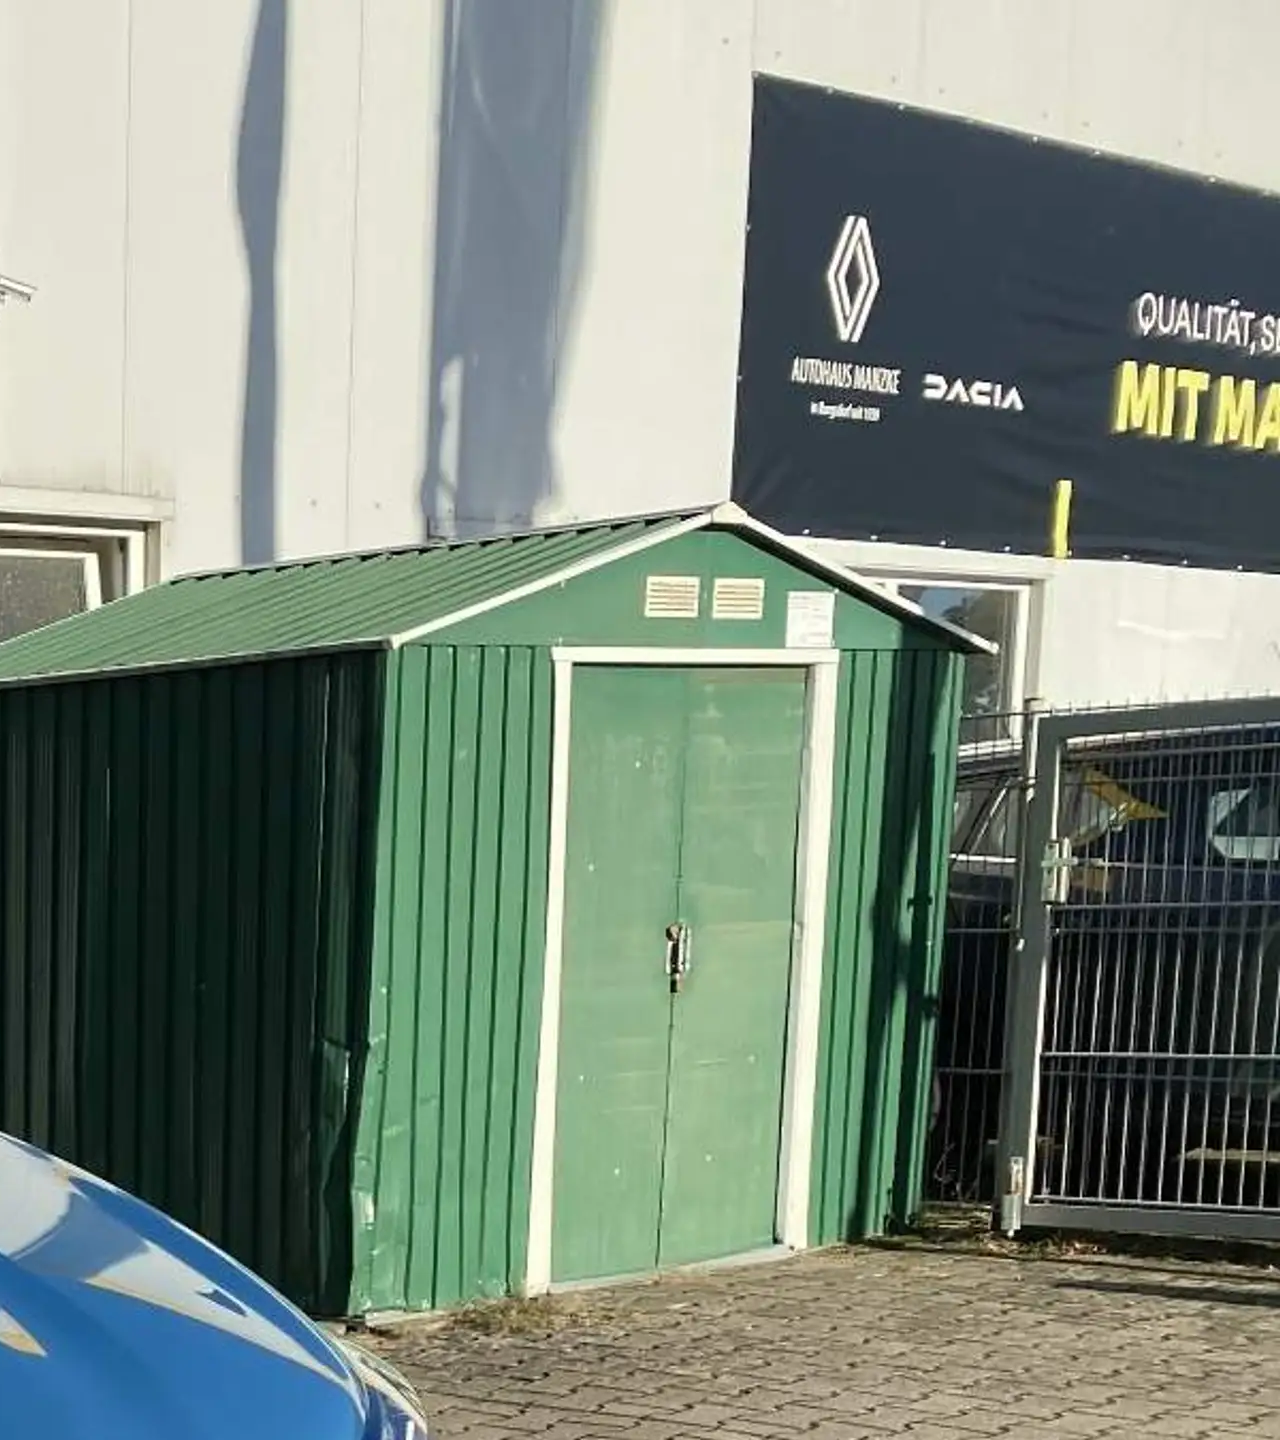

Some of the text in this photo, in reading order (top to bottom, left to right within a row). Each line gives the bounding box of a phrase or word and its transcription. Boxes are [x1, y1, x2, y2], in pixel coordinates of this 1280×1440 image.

[1138, 292, 1256, 356] QUALITÄT,
[791, 356, 853, 388] AUTOHAUS
[922, 373, 1024, 412] DACIA
[1114, 360, 1210, 441] MIT
